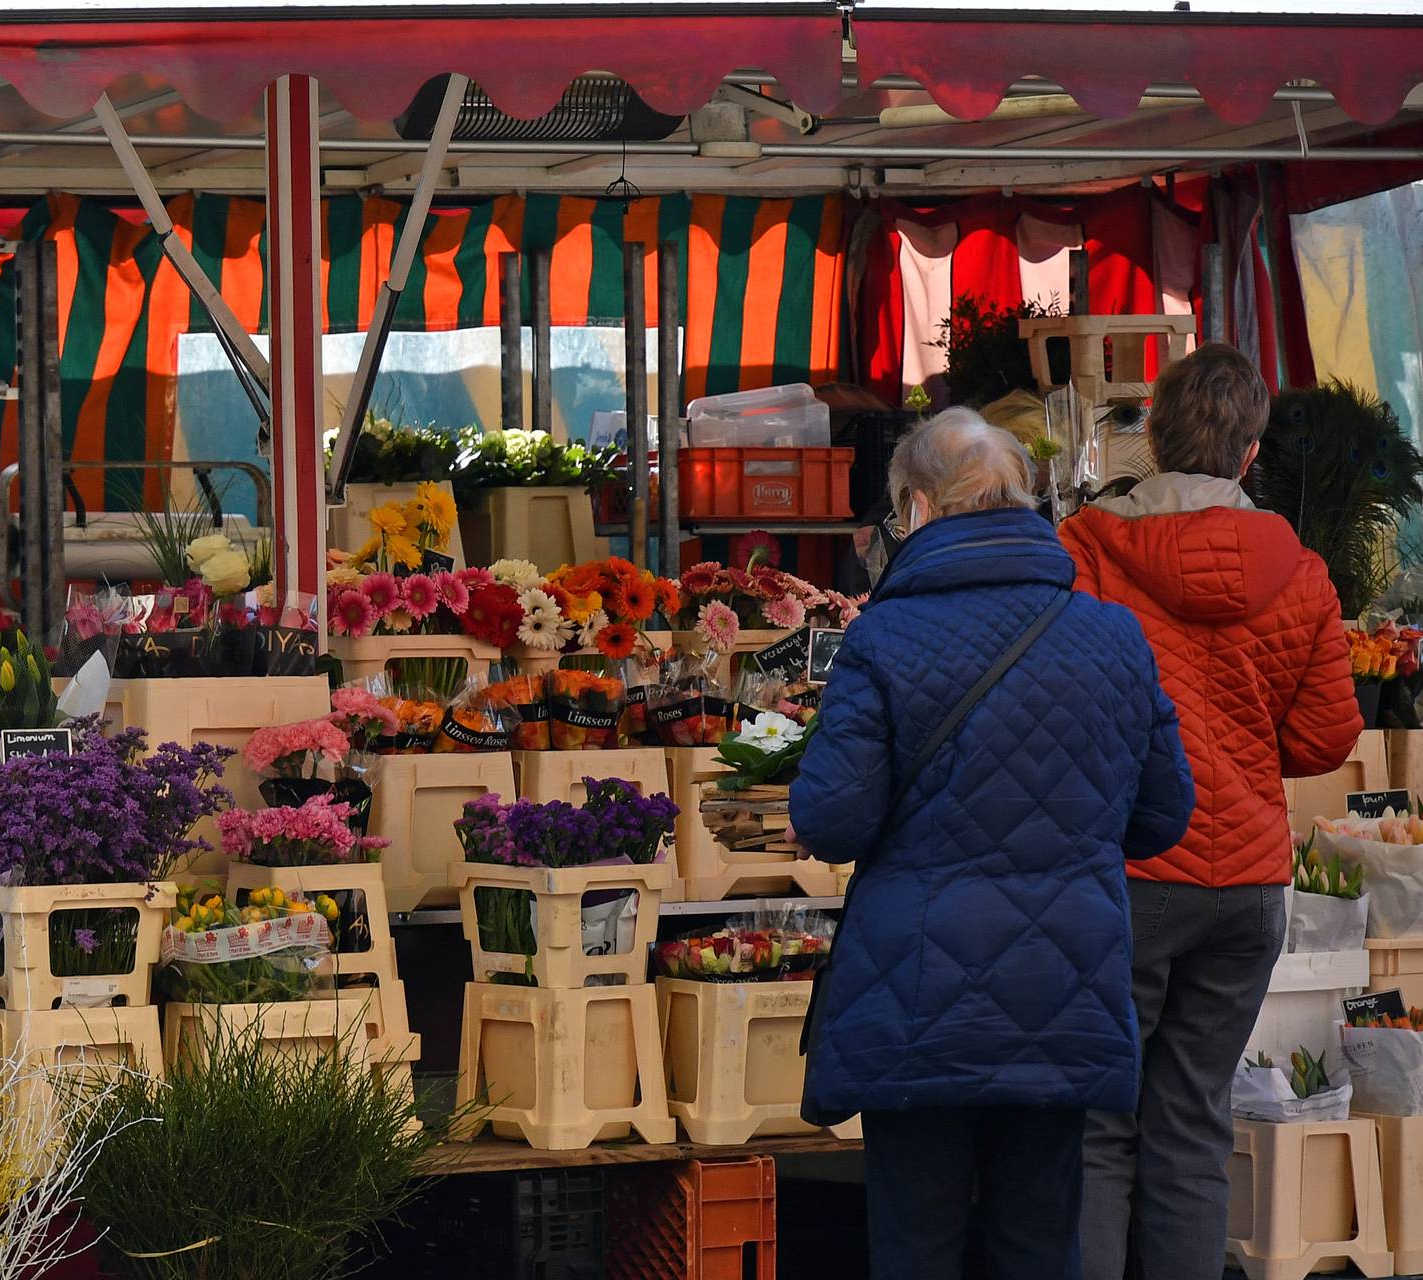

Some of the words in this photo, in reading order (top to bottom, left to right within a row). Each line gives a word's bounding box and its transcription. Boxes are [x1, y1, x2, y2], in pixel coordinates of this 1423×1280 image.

[567, 711, 612, 727] Linssen
[657, 707, 683, 723] Roses
[7, 734, 56, 744] Limonium
[444, 721, 484, 745] Linssen
